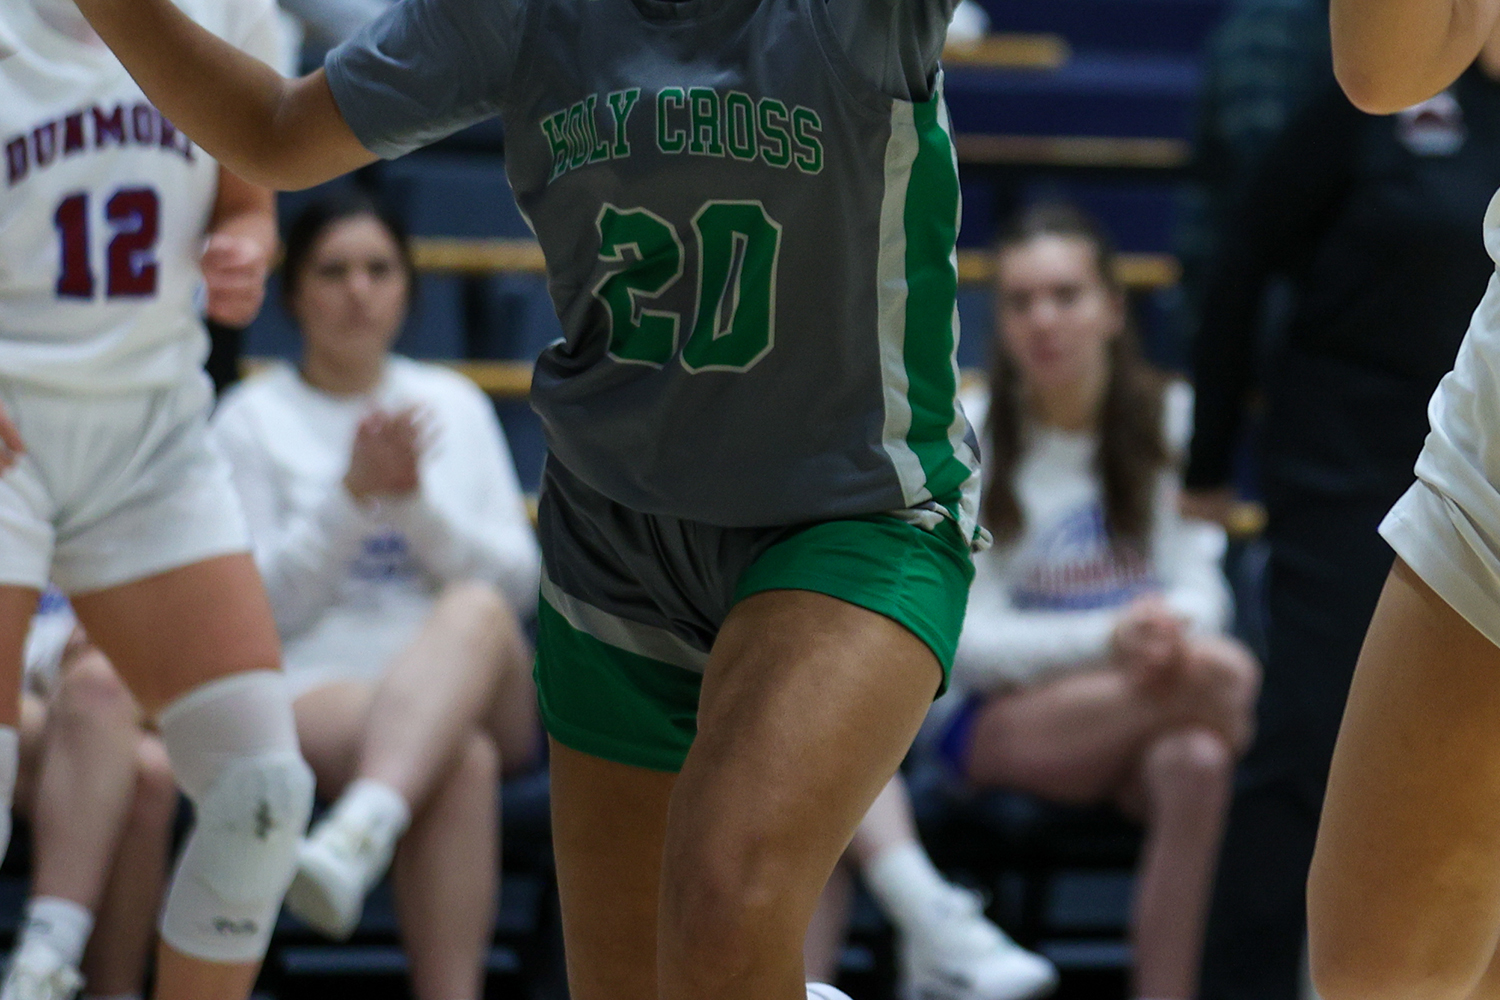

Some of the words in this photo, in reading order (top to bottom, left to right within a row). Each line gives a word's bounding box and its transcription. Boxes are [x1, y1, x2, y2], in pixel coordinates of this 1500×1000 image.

[540, 87, 641, 185] HOLY
[656, 86, 824, 175] CROSS
[54, 186, 162, 302] 12
[591, 199, 783, 375] 20
